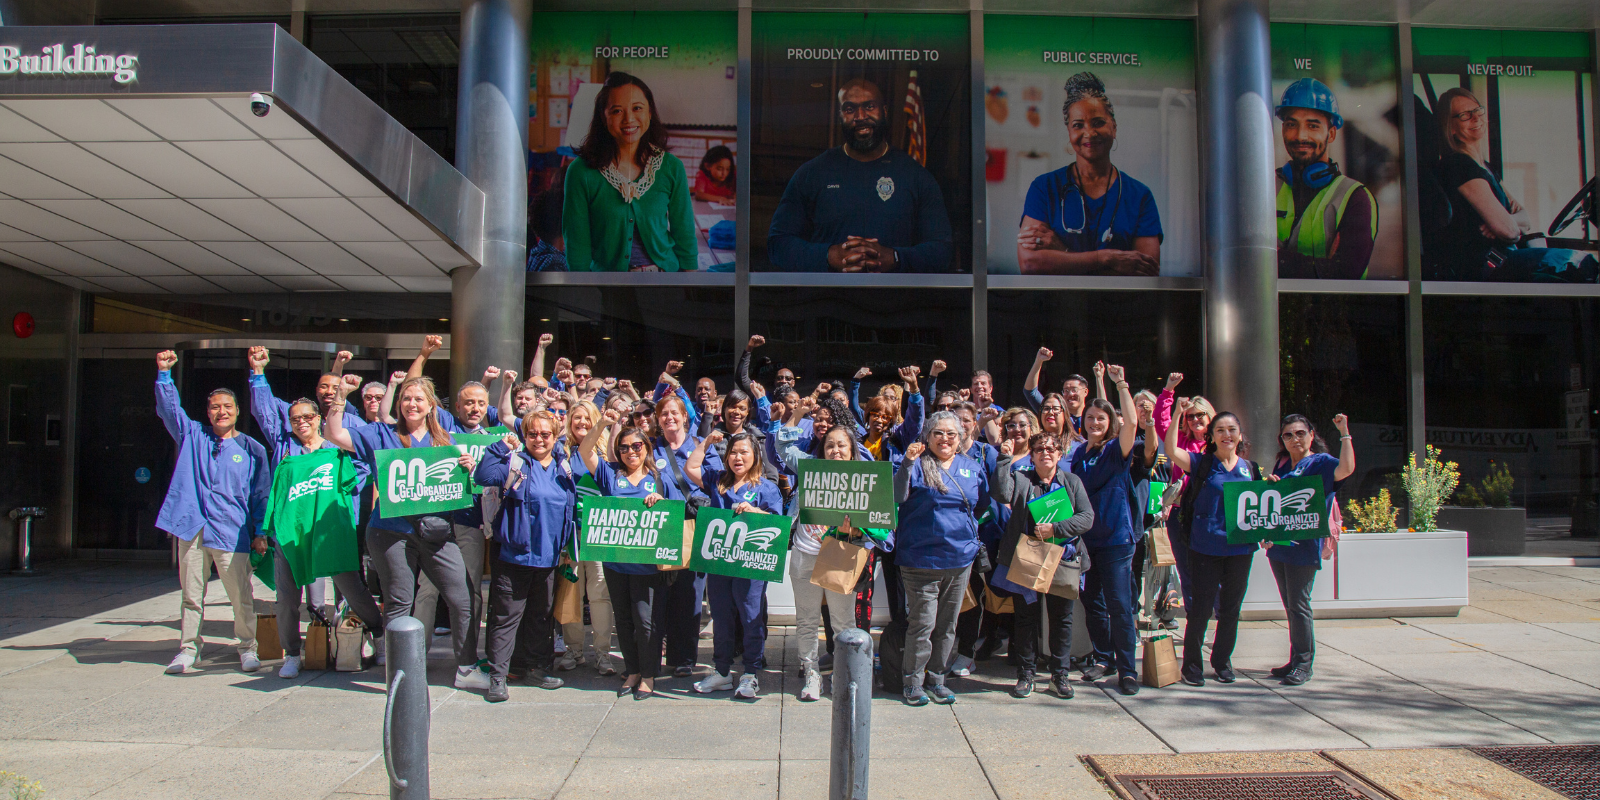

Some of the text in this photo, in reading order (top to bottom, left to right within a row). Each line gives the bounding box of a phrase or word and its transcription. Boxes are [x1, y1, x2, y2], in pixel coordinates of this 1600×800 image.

[595, 46, 668, 58] FOR PEOPLE
[787, 48, 939, 61] PROUDLY COMMITTED TO
[1044, 51, 1142, 66] PUBLIC SERVICE,
[0, 43, 137, 84] Building
[1294, 58, 1312, 70] WE
[1467, 64, 1535, 76] NEVER QUIT.
[288, 474, 334, 499] AFSCME
[388, 458, 427, 504] GO
[400, 482, 463, 498] GET ORGANIZED
[804, 471, 878, 492] HANDS OFF
[428, 494, 462, 502] AFSCME
[804, 490, 870, 510] MEDICAID
[588, 508, 670, 529] HANDS OFF
[1236, 489, 1282, 531] GO
[1249, 512, 1319, 527] GET ORGANIZED
[1284, 522, 1319, 532] AFSCME
[586, 526, 658, 546] MEDICAID
[701, 518, 748, 563] GO
[714, 542, 778, 565] GET ORGANIZED
[742, 561, 776, 572] AFSCME
